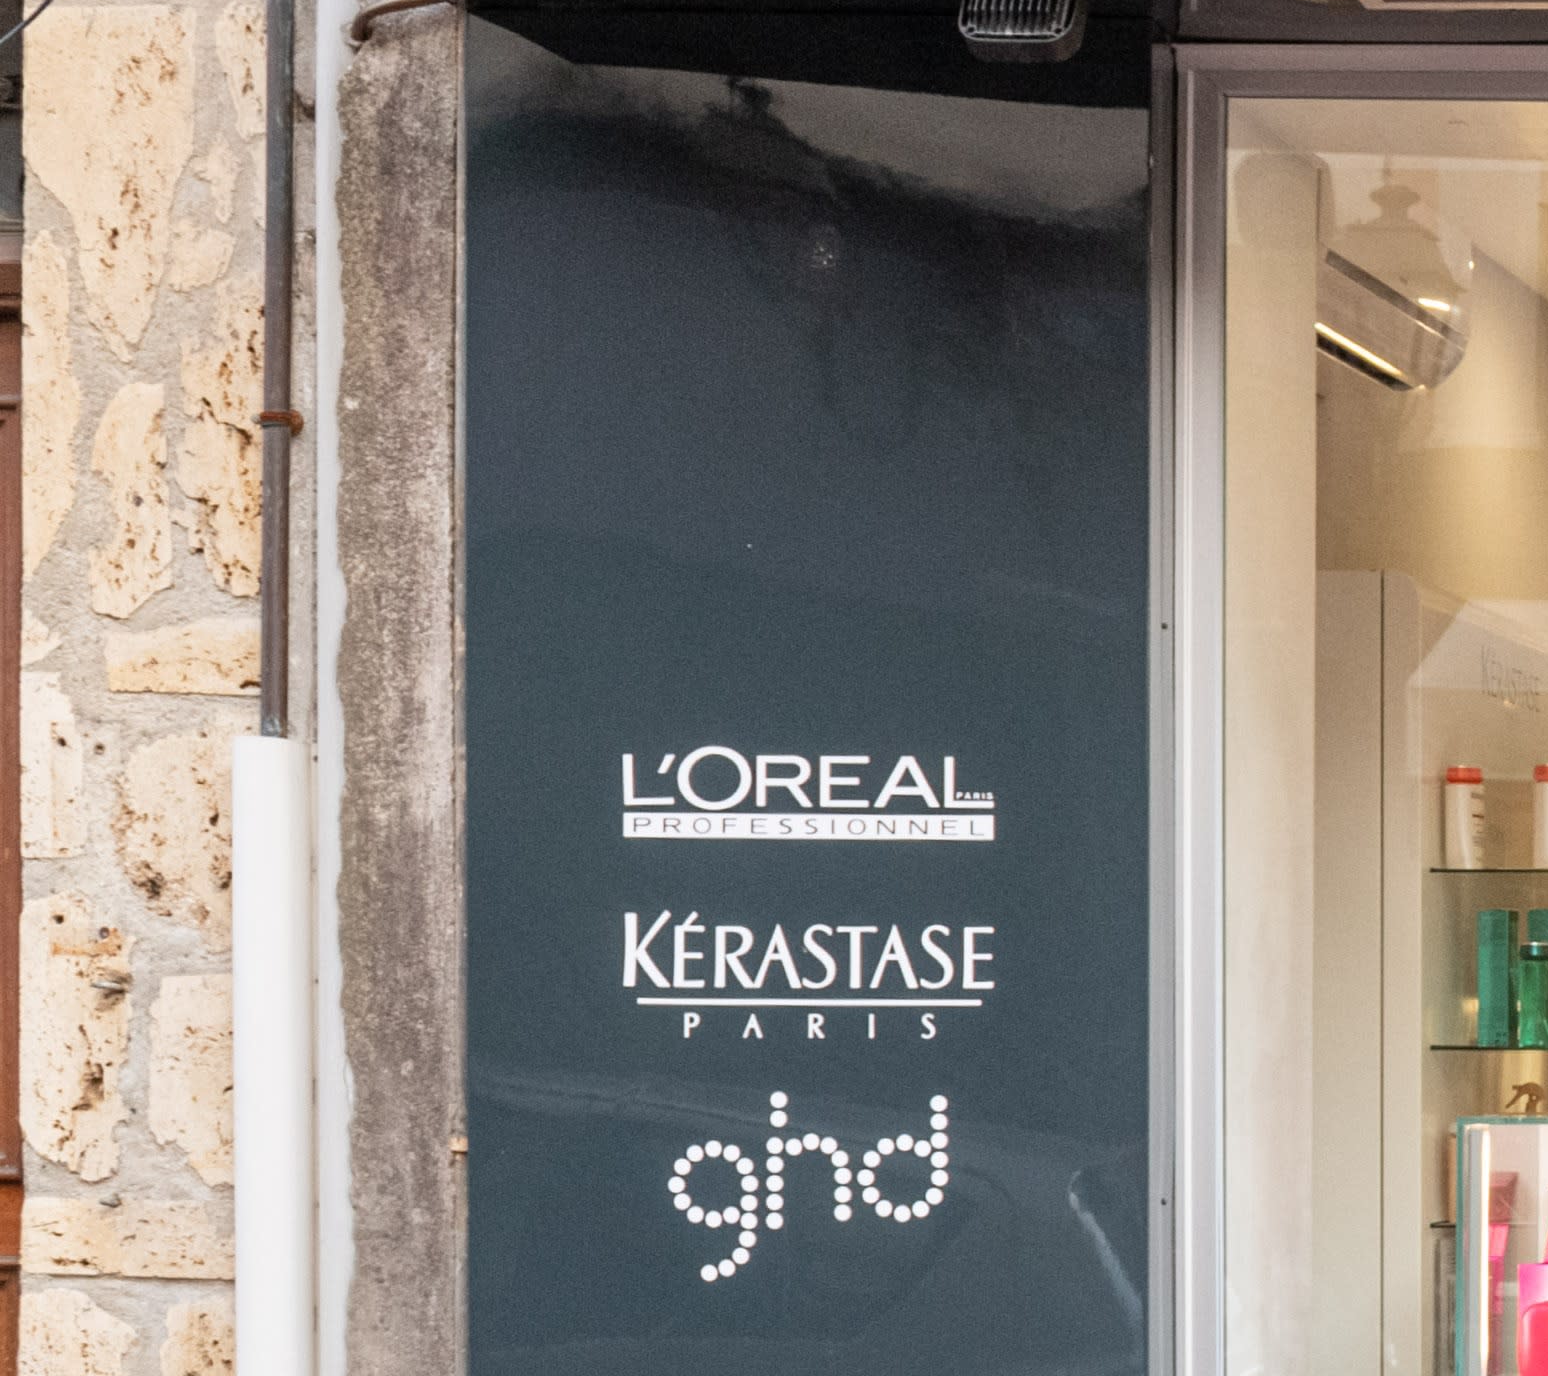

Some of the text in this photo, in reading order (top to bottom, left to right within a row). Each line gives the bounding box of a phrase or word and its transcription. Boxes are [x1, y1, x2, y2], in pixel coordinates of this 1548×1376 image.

[622, 746, 995, 810] L'OREAL PARIS
[633, 817, 985, 837] PROFESSIONNEL
[623, 910, 995, 989] KÉRASTASE
[683, 1013, 937, 1039] PARIS
